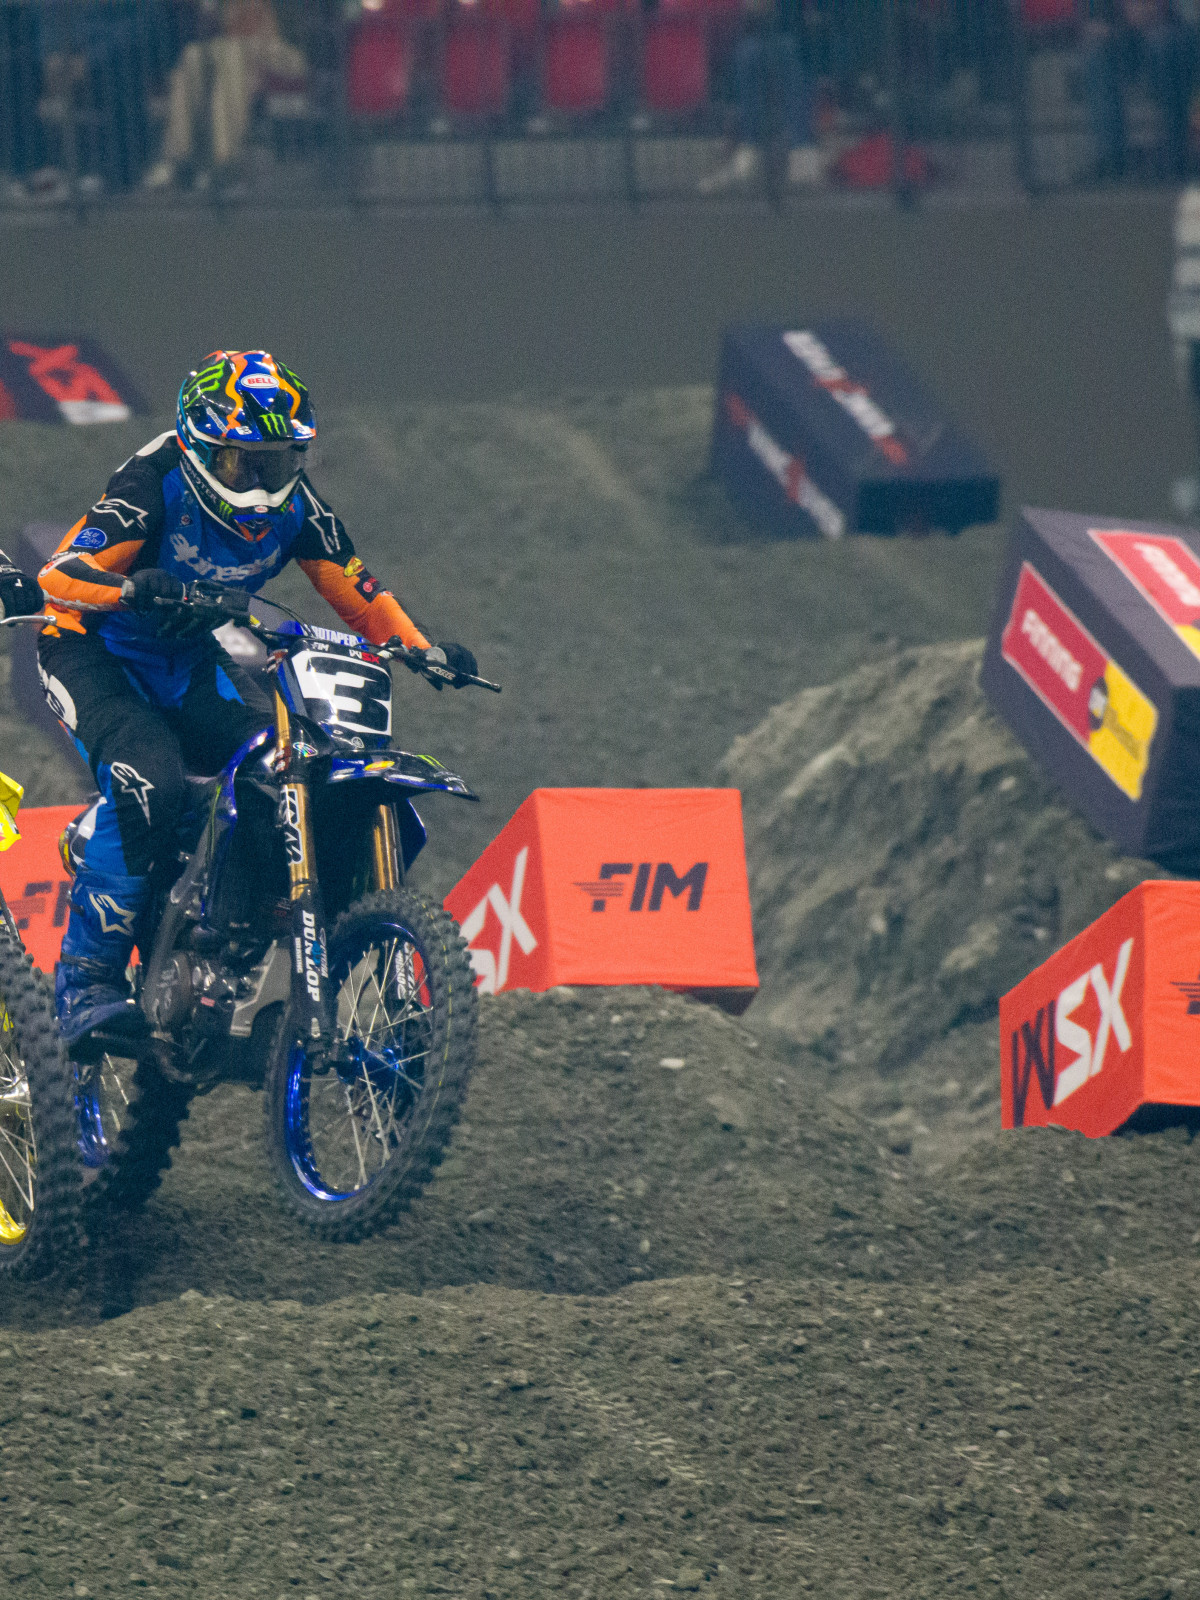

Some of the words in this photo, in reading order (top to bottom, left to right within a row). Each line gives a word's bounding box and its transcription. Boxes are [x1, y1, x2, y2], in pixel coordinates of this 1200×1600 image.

[247, 377, 274, 385] BELL
[182, 454, 217, 503] MONSTER
[311, 641, 329, 652] FIM
[349, 649, 380, 664] WSX
[306, 656, 391, 734] 3
[573, 862, 709, 912] FIM
[460, 846, 538, 995] SX
[302, 910, 320, 1001] DUNLOP
[1011, 937, 1134, 1128] WSX
